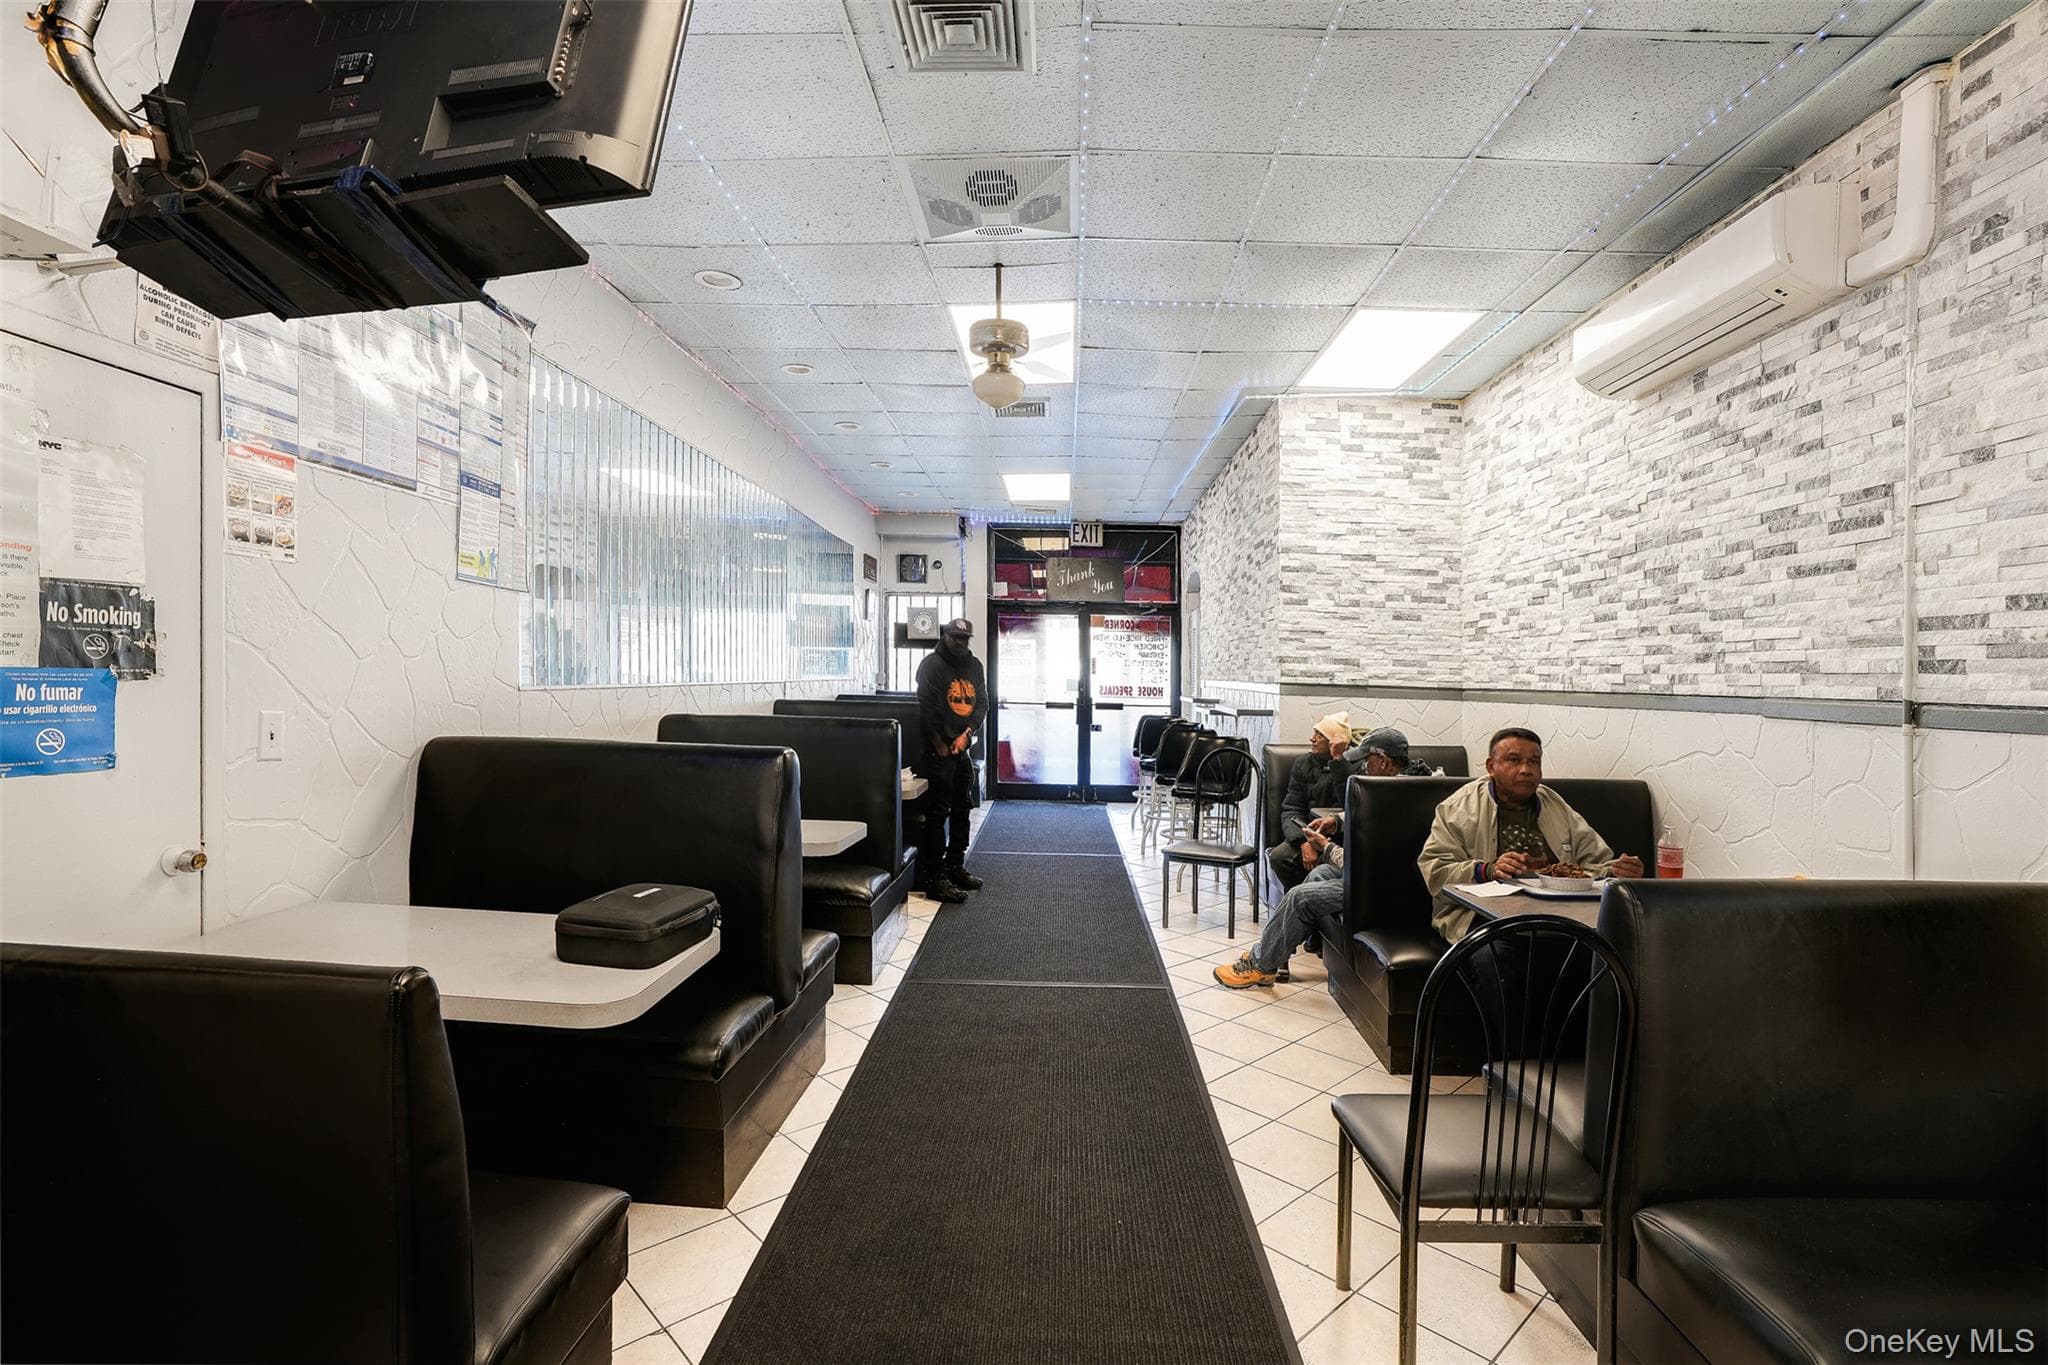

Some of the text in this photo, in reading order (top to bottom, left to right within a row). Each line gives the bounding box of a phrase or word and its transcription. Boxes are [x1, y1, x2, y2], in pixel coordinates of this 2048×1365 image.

[139, 283, 178, 305] ALCOHOLIC
[143, 294, 172, 310] DURING
[161, 310, 175, 321] CAN
[155, 316, 201, 340] BIRTH DEFECTS
[1072, 523, 1100, 543] EXIT
[1056, 561, 1095, 587] Thank
[1091, 579, 1114, 594] You
[46, 601, 142, 629] No Smoking
[16, 683, 84, 701] No fumar
[3, 703, 97, 715] usar cigarrillo electrónico
